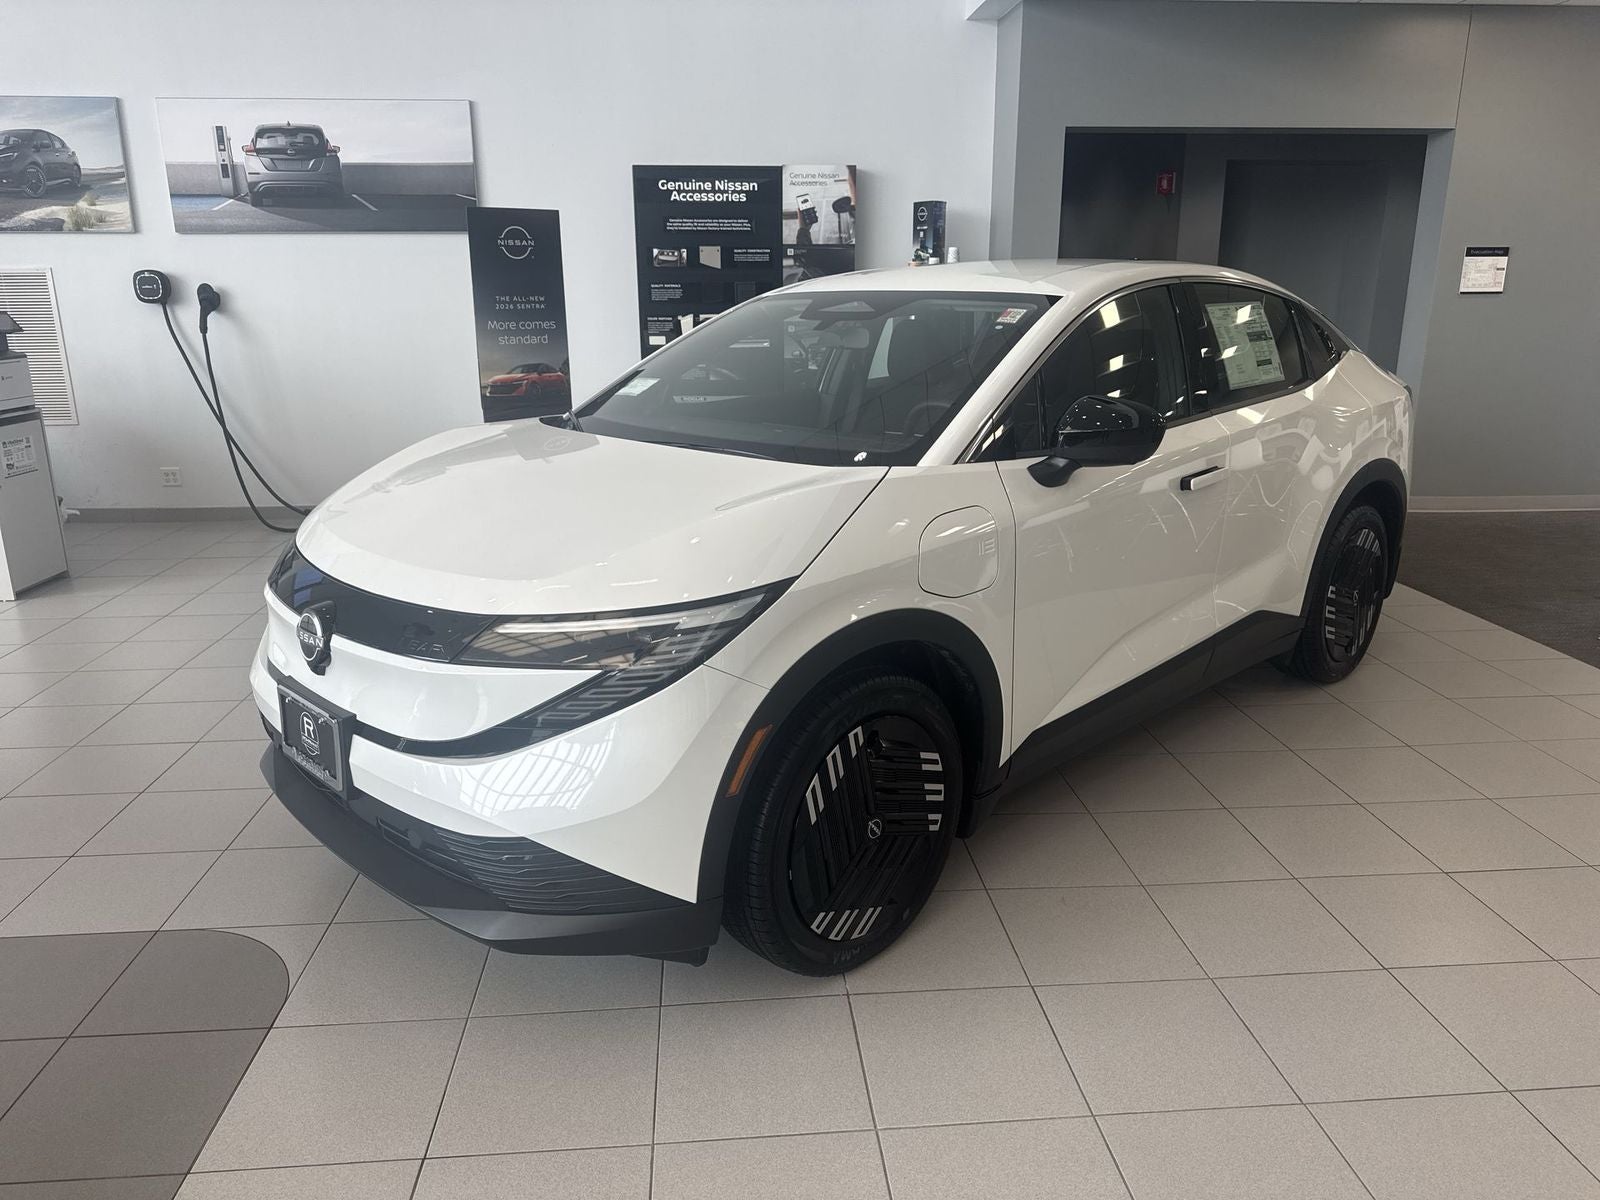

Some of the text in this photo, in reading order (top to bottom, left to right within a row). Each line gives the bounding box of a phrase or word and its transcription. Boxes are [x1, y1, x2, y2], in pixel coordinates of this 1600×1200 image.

[658, 179, 758, 191] Genuine Nissan
[670, 190, 747, 202] Accessories
[488, 321, 556, 330] More comes
[498, 334, 548, 344] standard
[299, 631, 324, 648] SSAN
[303, 717, 315, 739] R
